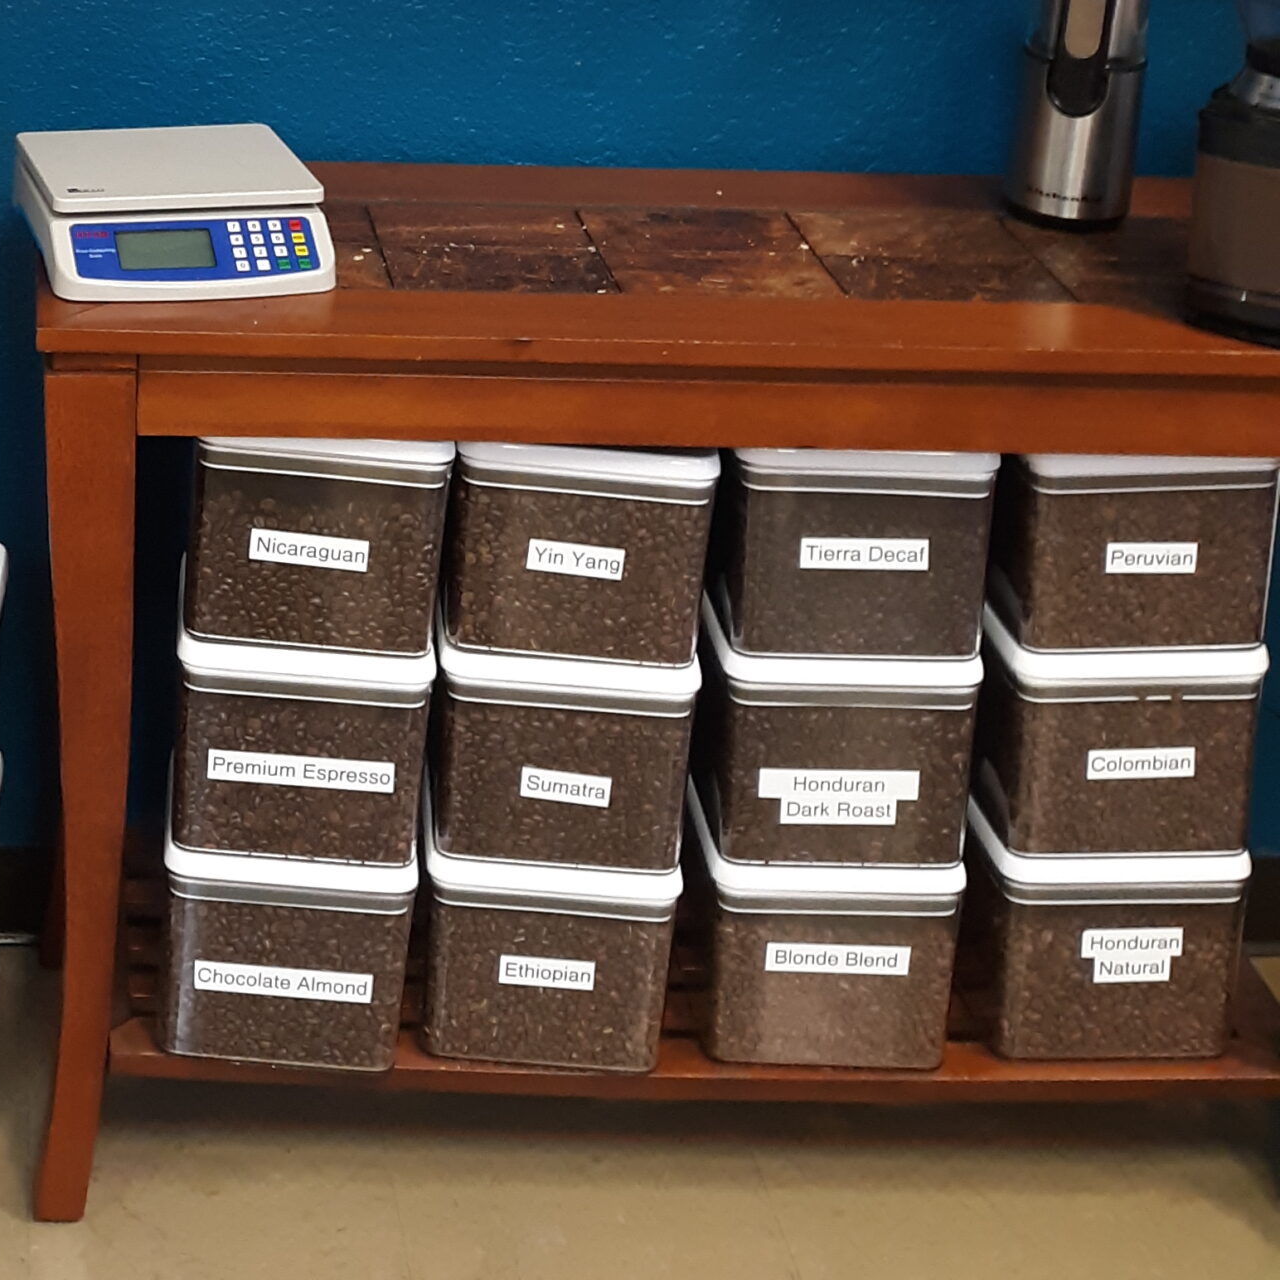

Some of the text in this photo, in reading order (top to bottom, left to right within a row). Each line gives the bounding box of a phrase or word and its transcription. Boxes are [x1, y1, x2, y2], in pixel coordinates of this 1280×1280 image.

[255, 536, 367, 565] Nicaraguan
[534, 546, 622, 574] Yin Yang
[805, 544, 926, 564] Tierra Decaf
[1110, 549, 1194, 567] Peruvian
[212, 757, 392, 789] Premium Espresso
[1091, 753, 1192, 773] Colombian
[526, 774, 606, 800] Sumatra
[792, 776, 886, 794] Honduran
[786, 800, 892, 819] Dark Roast
[1090, 935, 1180, 953] Honduran
[774, 950, 899, 969] Blonde Blend
[1098, 960, 1165, 977] Natural
[197, 966, 368, 997] Chocolate Almond
[505, 961, 592, 986] Ethiopian
